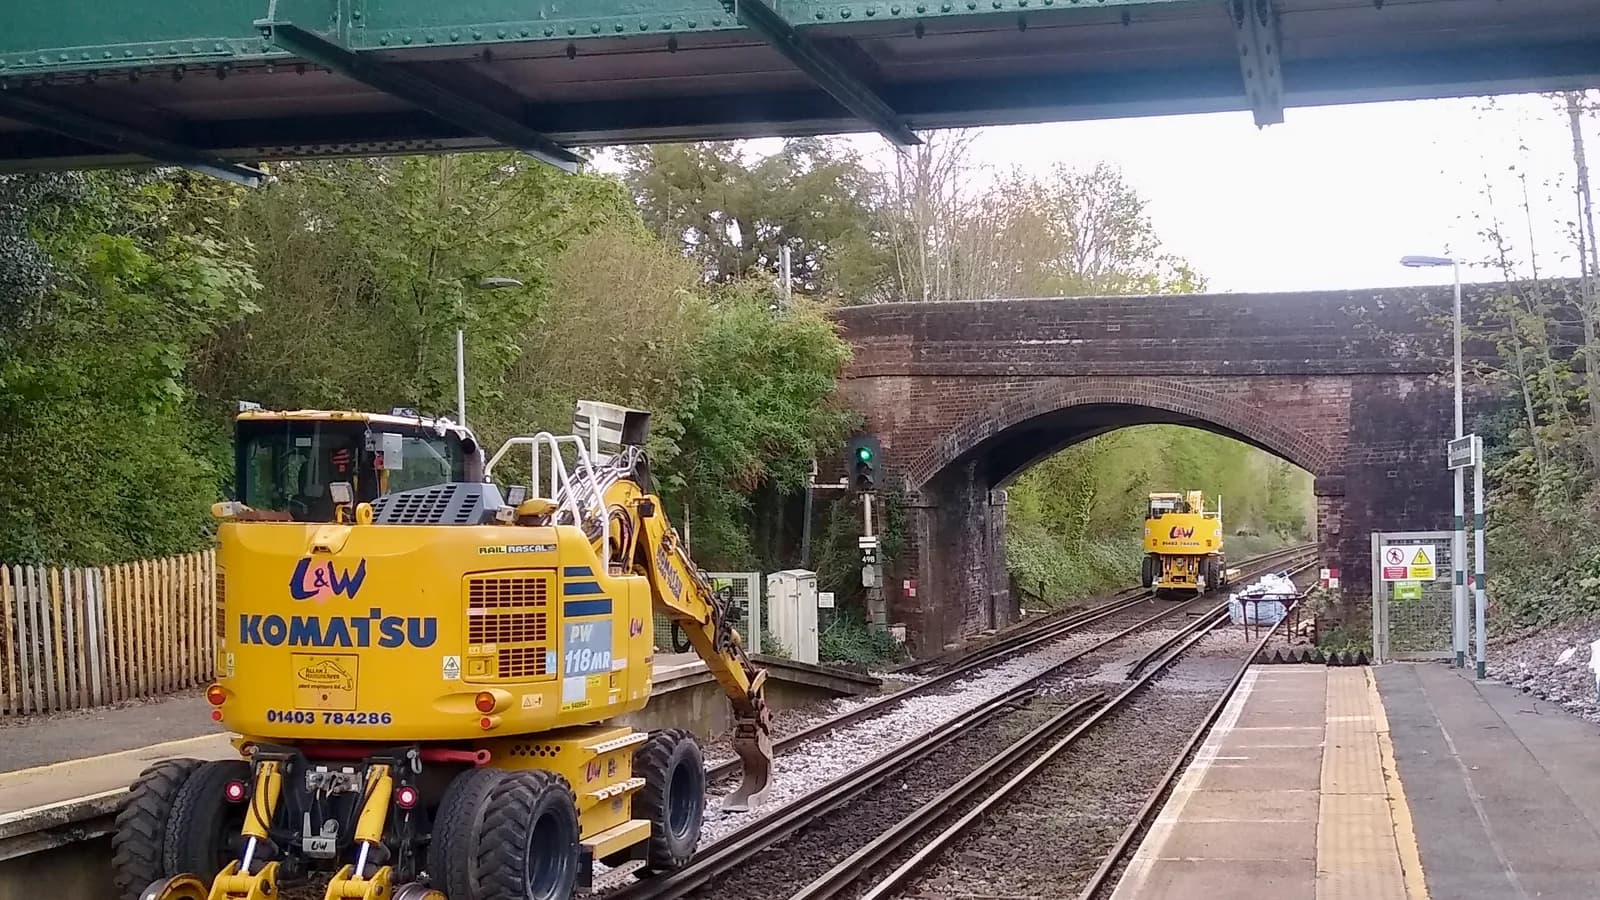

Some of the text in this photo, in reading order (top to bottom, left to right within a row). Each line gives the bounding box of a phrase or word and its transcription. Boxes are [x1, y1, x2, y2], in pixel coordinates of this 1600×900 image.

[507, 545, 548, 553] RASCAL
[289, 557, 366, 600] L&W
[240, 607, 437, 648] KOMATSU
[570, 623, 593, 643] PW
[267, 709, 392, 725] 01403 784286
